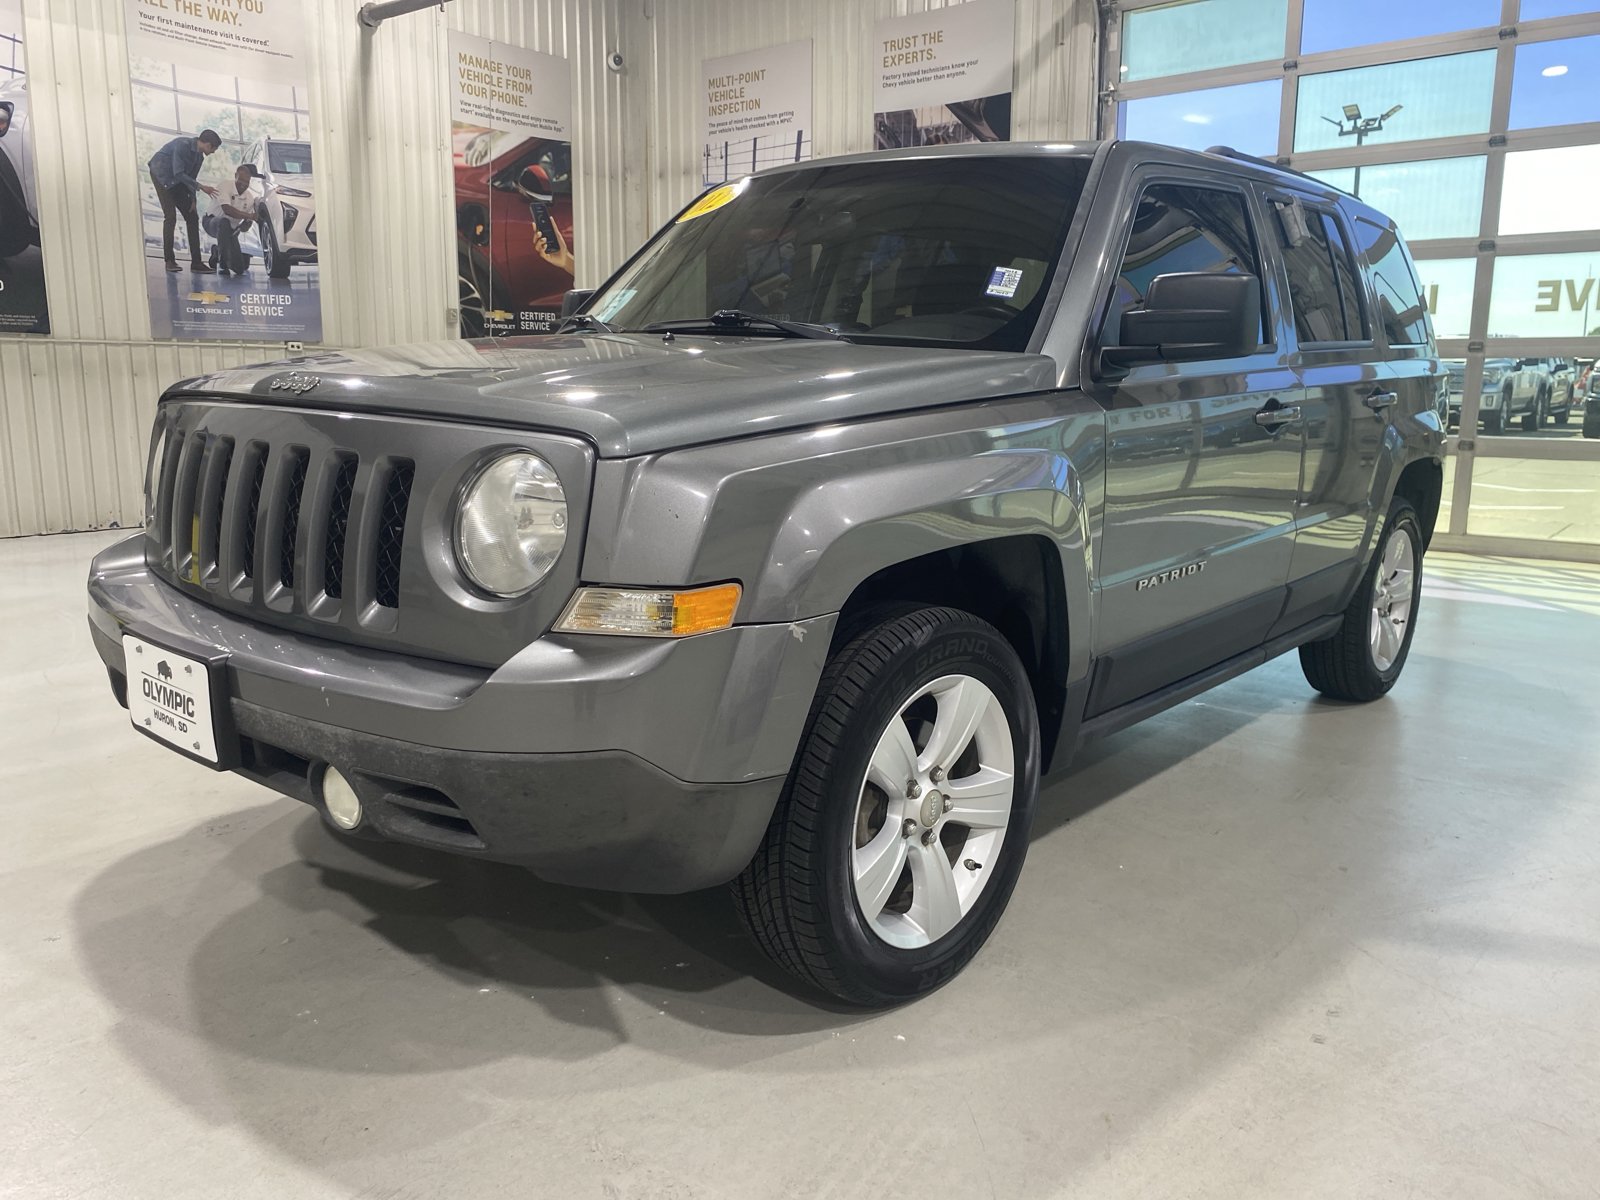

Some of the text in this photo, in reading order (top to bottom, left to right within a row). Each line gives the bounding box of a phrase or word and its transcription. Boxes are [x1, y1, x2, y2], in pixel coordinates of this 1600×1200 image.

[175, 0, 202, 17] THE
[207, 6, 242, 26] WAY.
[138, 11, 155, 20] Your
[157, 15, 173, 25] first
[174, 21, 218, 36] maintenance
[219, 31, 234, 39] visit
[883, 30, 943, 53] TRUST THE
[459, 52, 532, 81] MANAGE YOUR
[883, 48, 936, 68] EXPERTS.
[459, 66, 533, 95] VEHICLE FROM
[708, 69, 766, 90] MULTI-POINT
[902, 70, 920, 78] trained
[921, 65, 950, 75] technicians
[459, 81, 528, 108] YOUR PHONE.
[708, 87, 745, 103] VEHICLE
[495, 108, 520, 118] diagnostics
[708, 98, 761, 117] INSPECTION
[186, 294, 292, 315] CHEVROLET CERTIFIED
[241, 306, 284, 317] SERVICE
[520, 311, 556, 321] CERTIFIED
[520, 321, 551, 331] SERVICE
[1136, 560, 1208, 592] PATRIOT
[142, 677, 195, 718] OLYMPIC
[153, 708, 188, 734] HURON, SD
